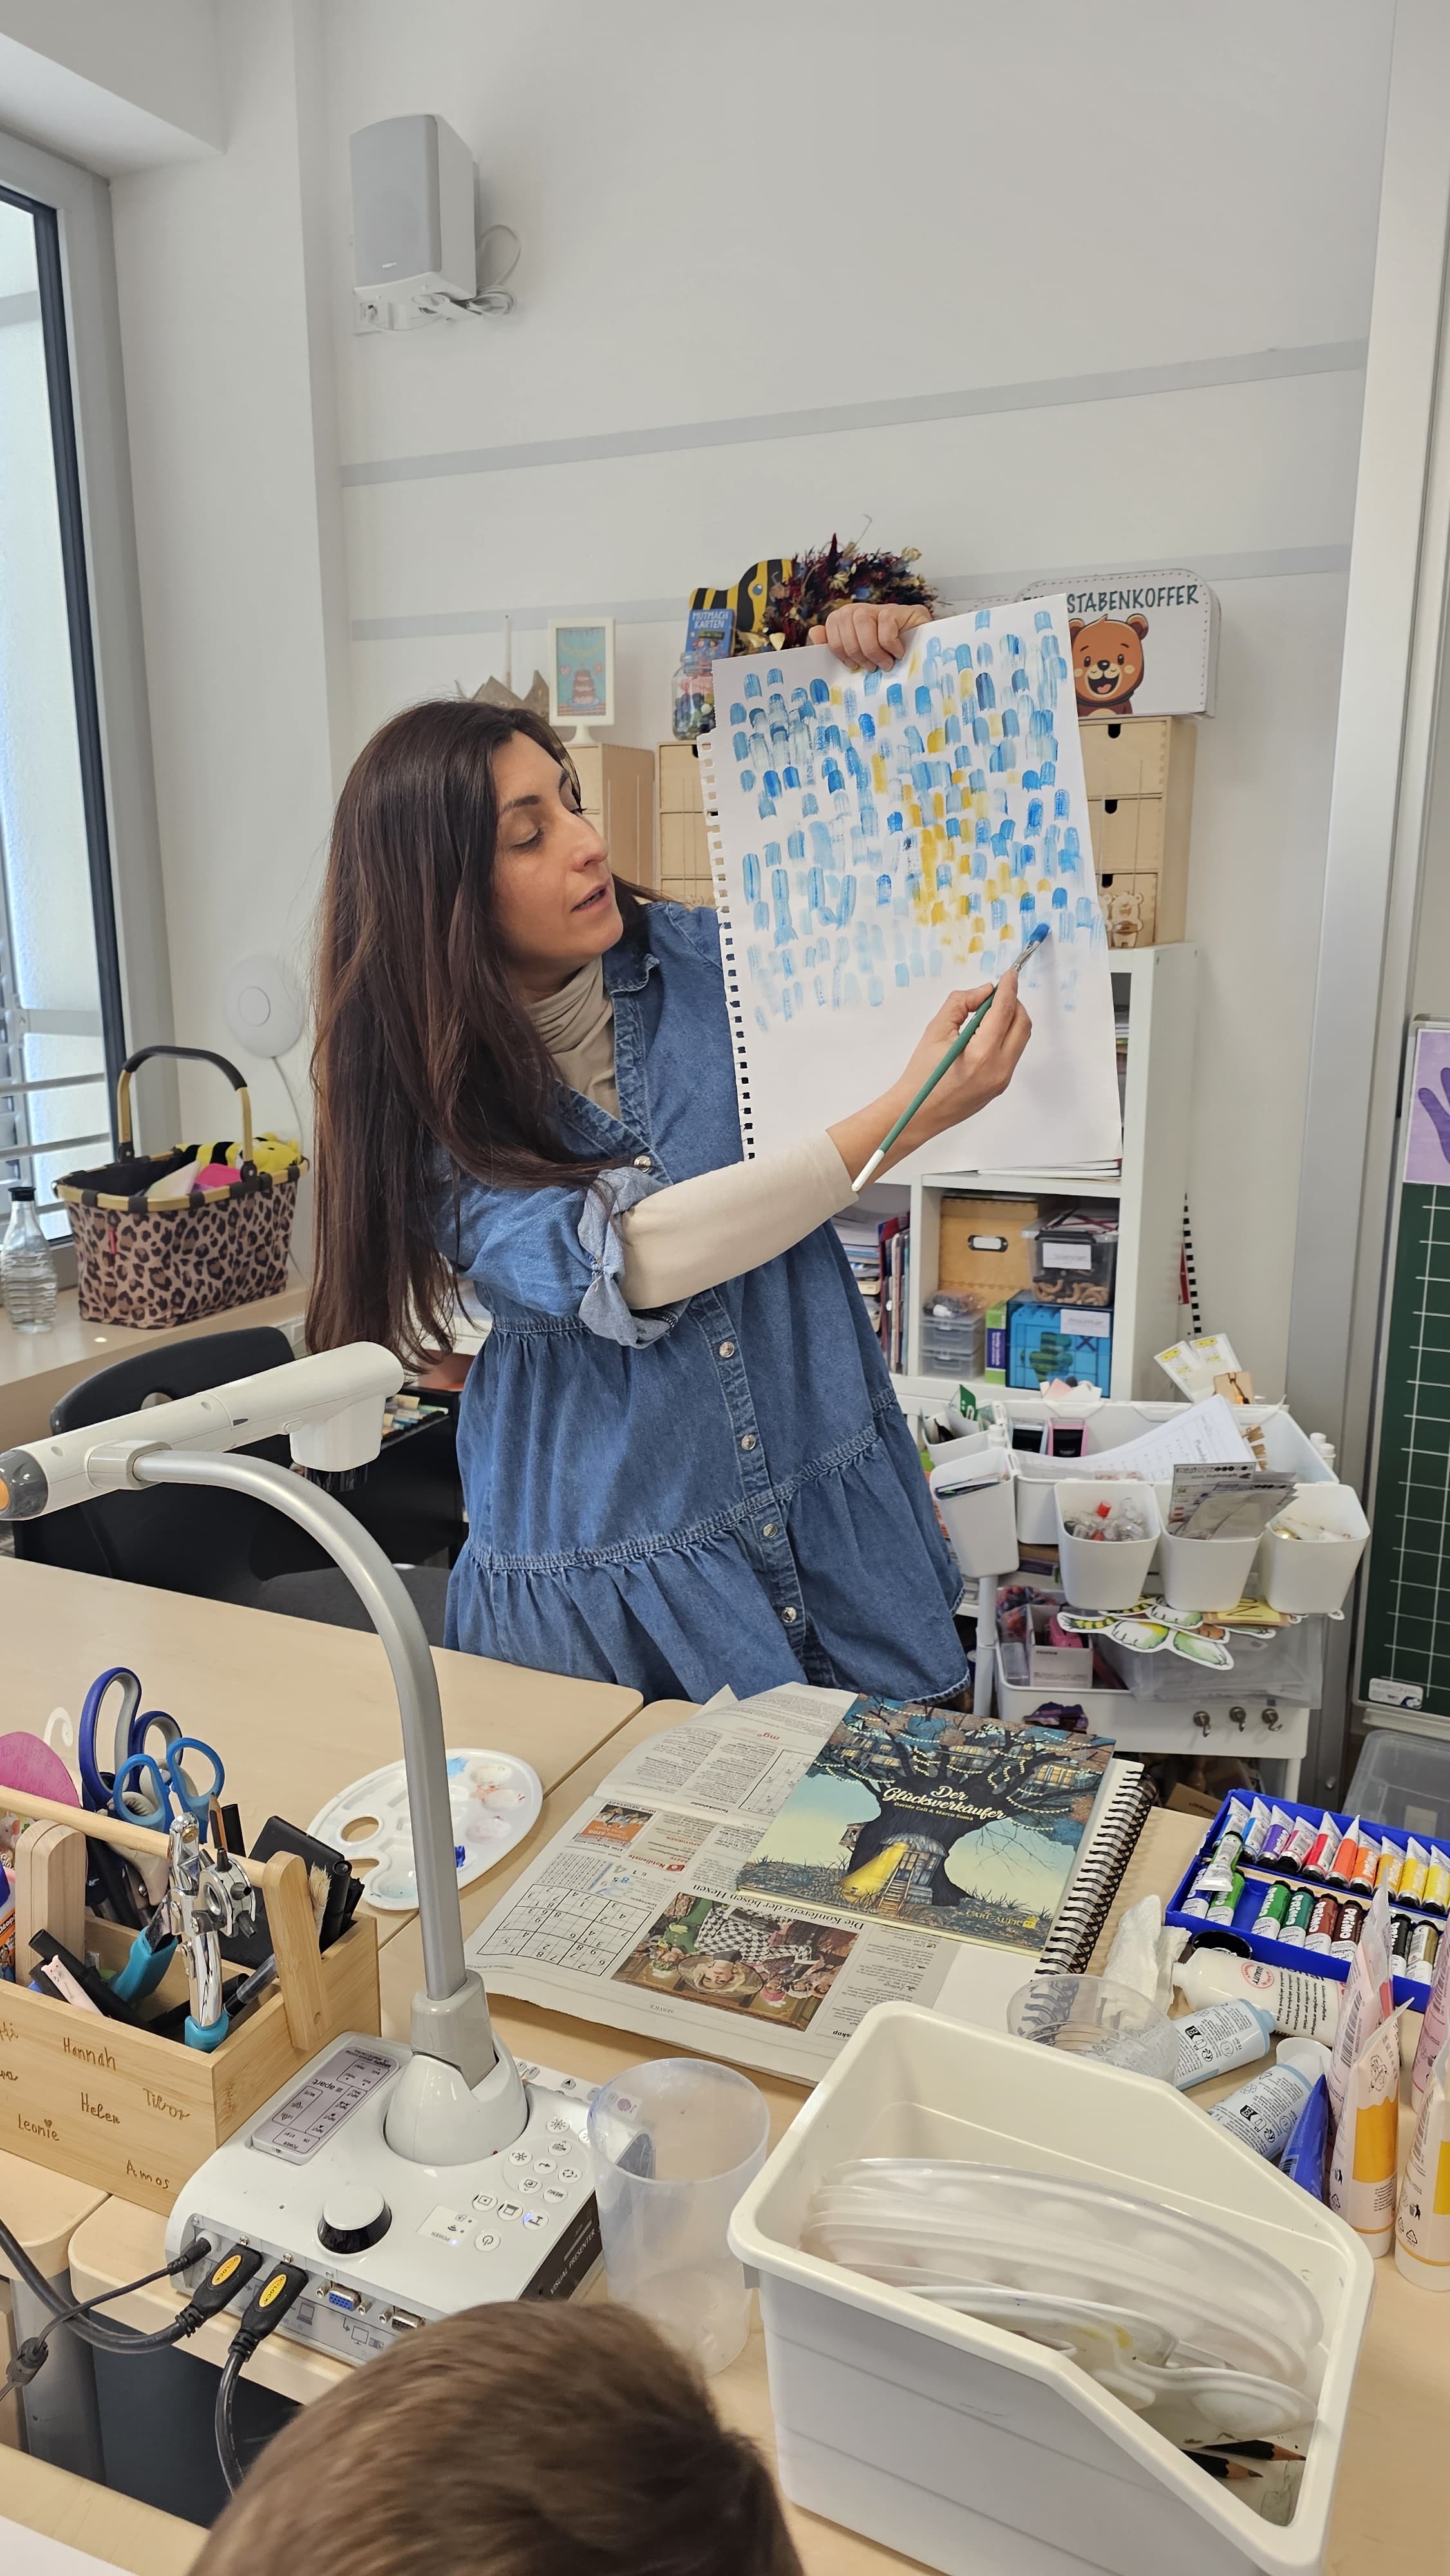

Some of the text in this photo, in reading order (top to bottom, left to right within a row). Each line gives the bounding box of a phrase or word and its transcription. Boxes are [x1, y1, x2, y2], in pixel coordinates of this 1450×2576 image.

[692, 612, 729, 620] MUTMACH
[694, 620, 725, 629] KARTEN
[930, 1785, 968, 1801] Der
[882, 1787, 1006, 1819] Glücksverkäufer
[894, 1802, 915, 1810] Davide
[627, 1855, 666, 1868] Notdienste
[692, 1884, 865, 1930] Die Konferenz der bösen Hexen
[312, 2078, 335, 2090] apart
[80, 2092, 120, 2124] Helen
[18, 2113, 60, 2141] Leonie
[126, 2159, 170, 2190] Amos
[547, 2190, 564, 2198] MENU
[431, 2231, 451, 2242] POWER
[551, 2228, 595, 2295] VISUAL PRESENTER
